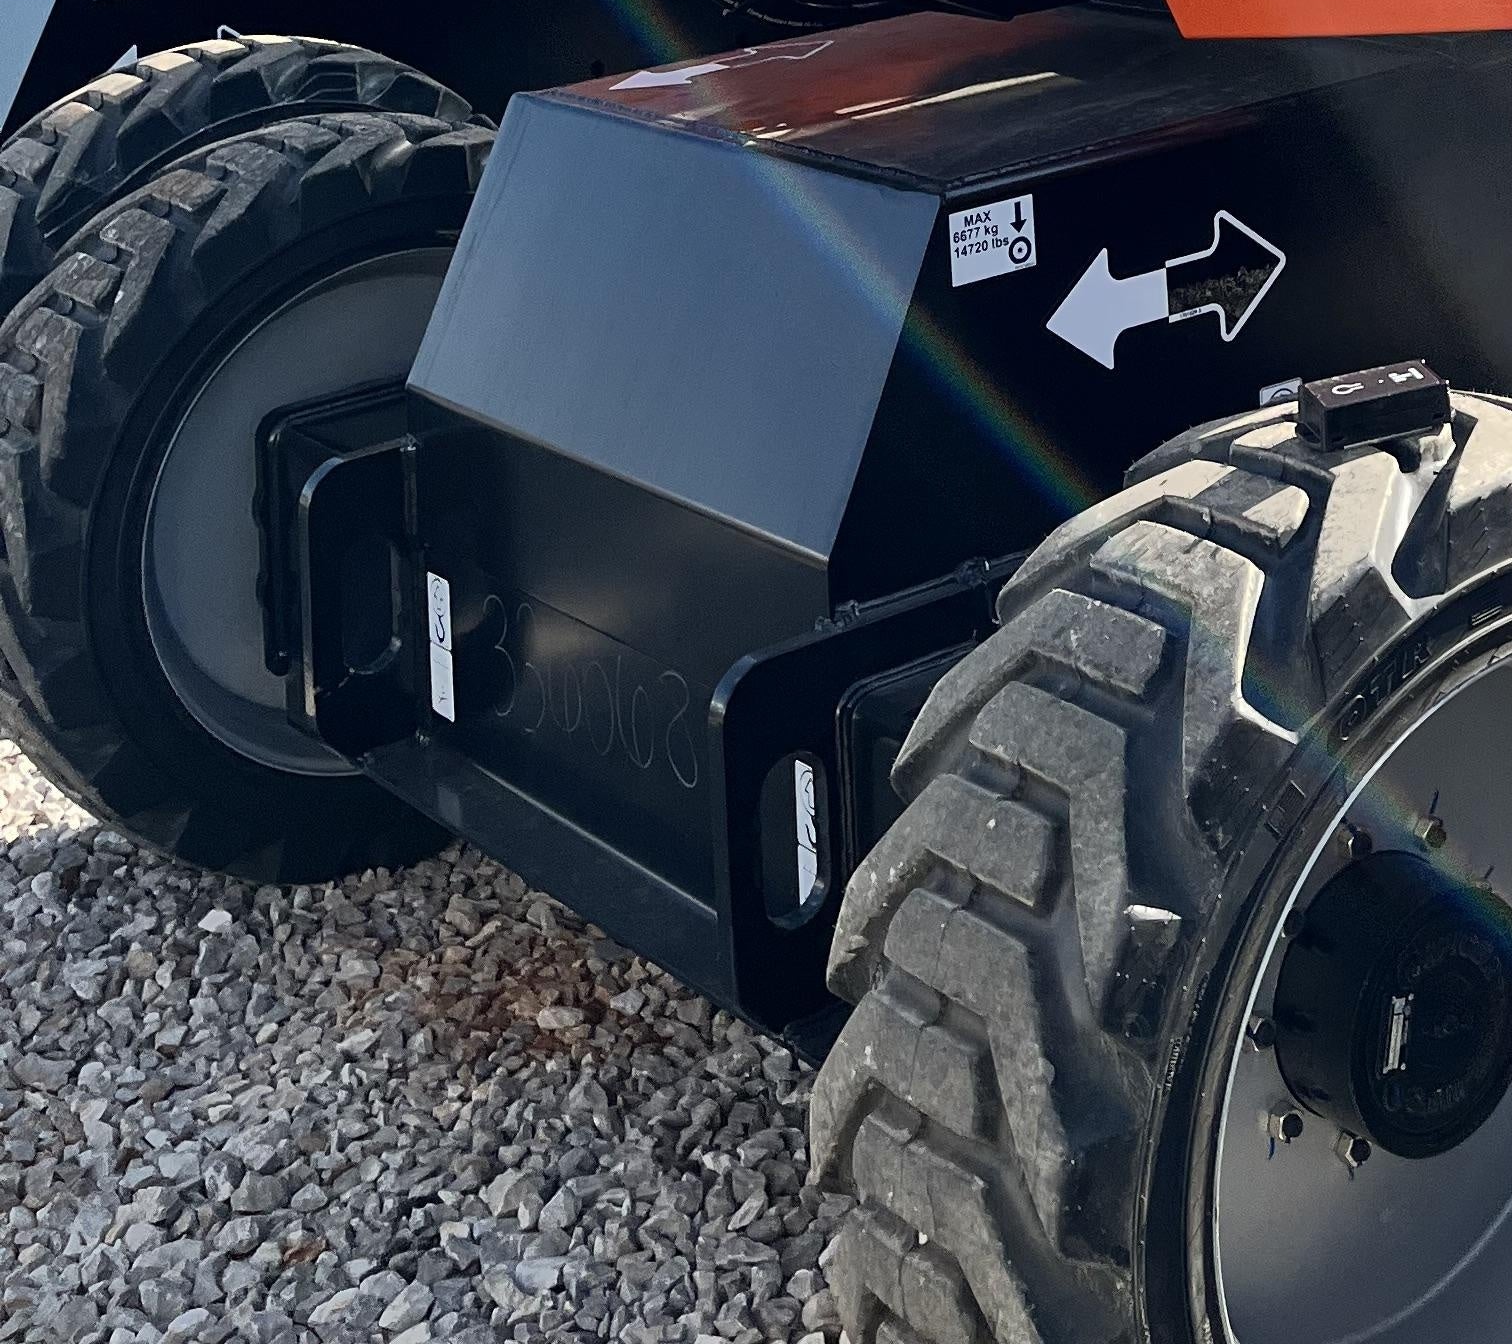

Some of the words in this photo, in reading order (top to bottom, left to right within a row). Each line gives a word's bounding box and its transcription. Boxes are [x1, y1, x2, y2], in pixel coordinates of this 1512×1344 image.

[963, 210, 992, 228] MAX
[953, 227, 981, 244] 6677
[983, 224, 999, 237] kg
[954, 240, 989, 259] 14720
[991, 236, 1010, 249] lbs
